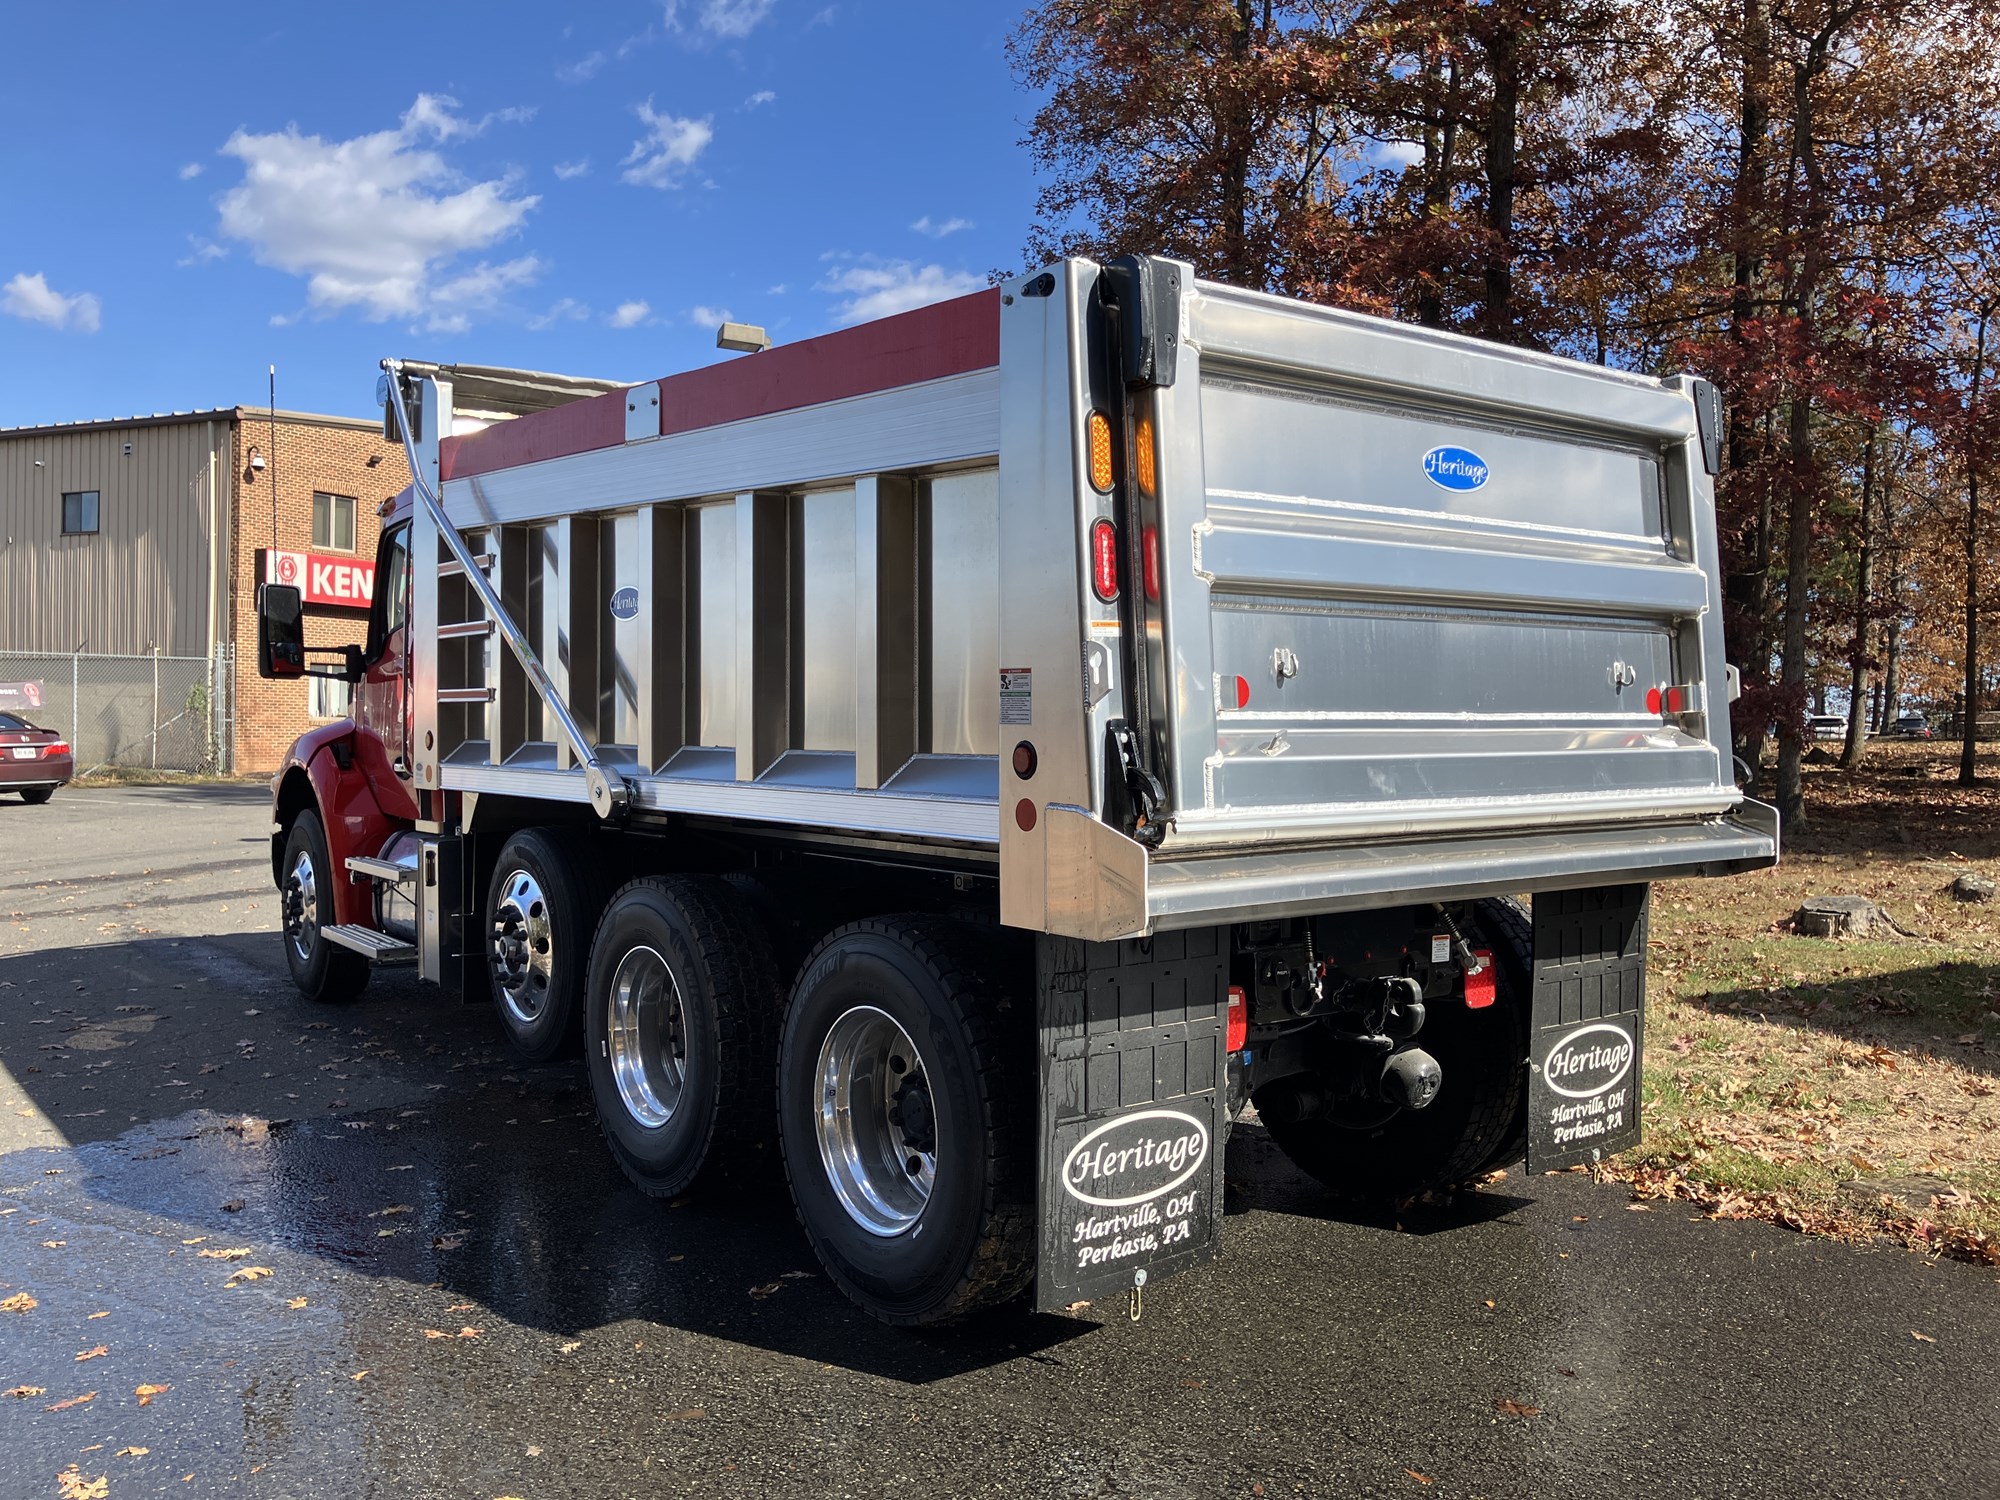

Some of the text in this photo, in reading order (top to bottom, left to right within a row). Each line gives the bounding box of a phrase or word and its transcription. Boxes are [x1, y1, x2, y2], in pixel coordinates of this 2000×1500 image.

[1426, 451, 1487, 485] Heritage
[312, 563, 373, 600] KEN
[1550, 1043, 1629, 1078] Heritage
[1550, 1088, 1627, 1125] Hartville, OH
[1553, 1111, 1623, 1144] Perkasie, PA
[1071, 1132, 1201, 1184] Heritage
[1073, 1190, 1198, 1243] Hartville, OH
[1078, 1220, 1191, 1268] Perkasie, PA
